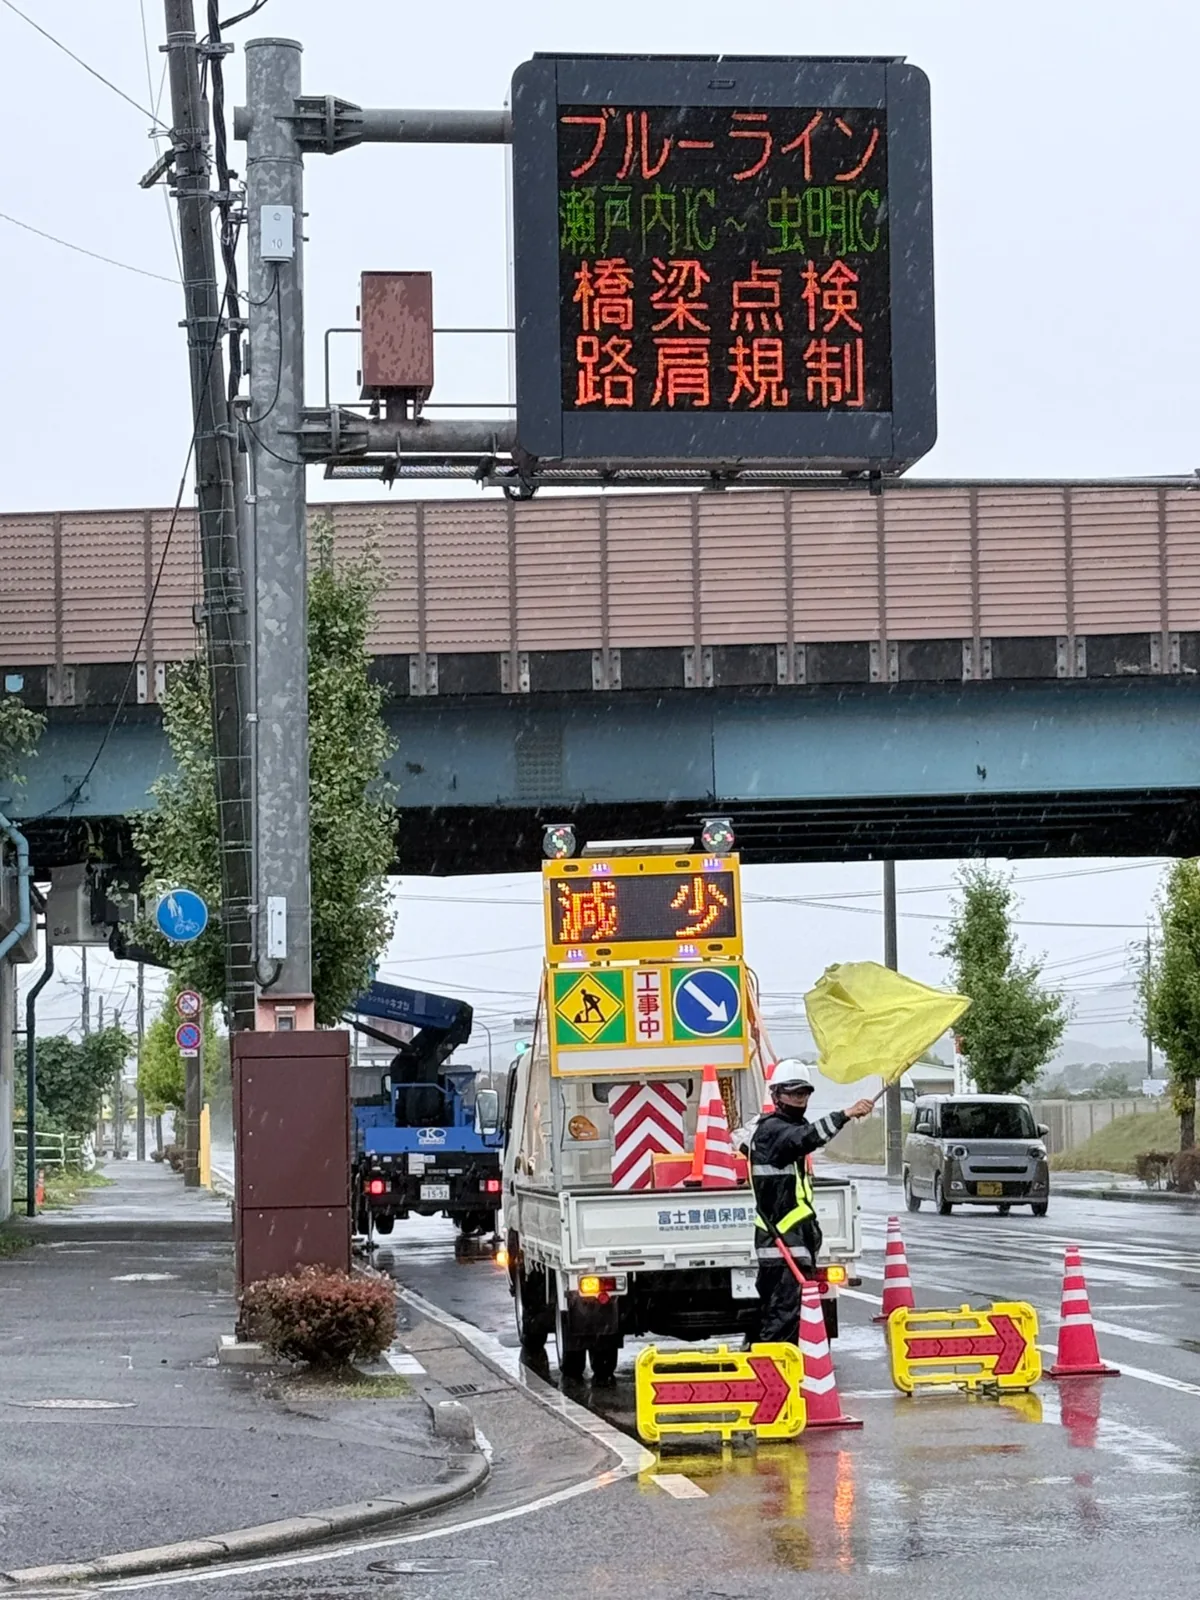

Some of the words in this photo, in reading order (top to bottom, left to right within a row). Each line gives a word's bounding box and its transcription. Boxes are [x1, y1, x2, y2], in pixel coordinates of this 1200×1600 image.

[560, 108, 880, 181] ブルーライン
[573, 257, 863, 332] 橋梁点検
[575, 335, 866, 408] 路肩規制
[557, 876, 728, 941] 減少
[636, 971, 660, 1039] 工事中
